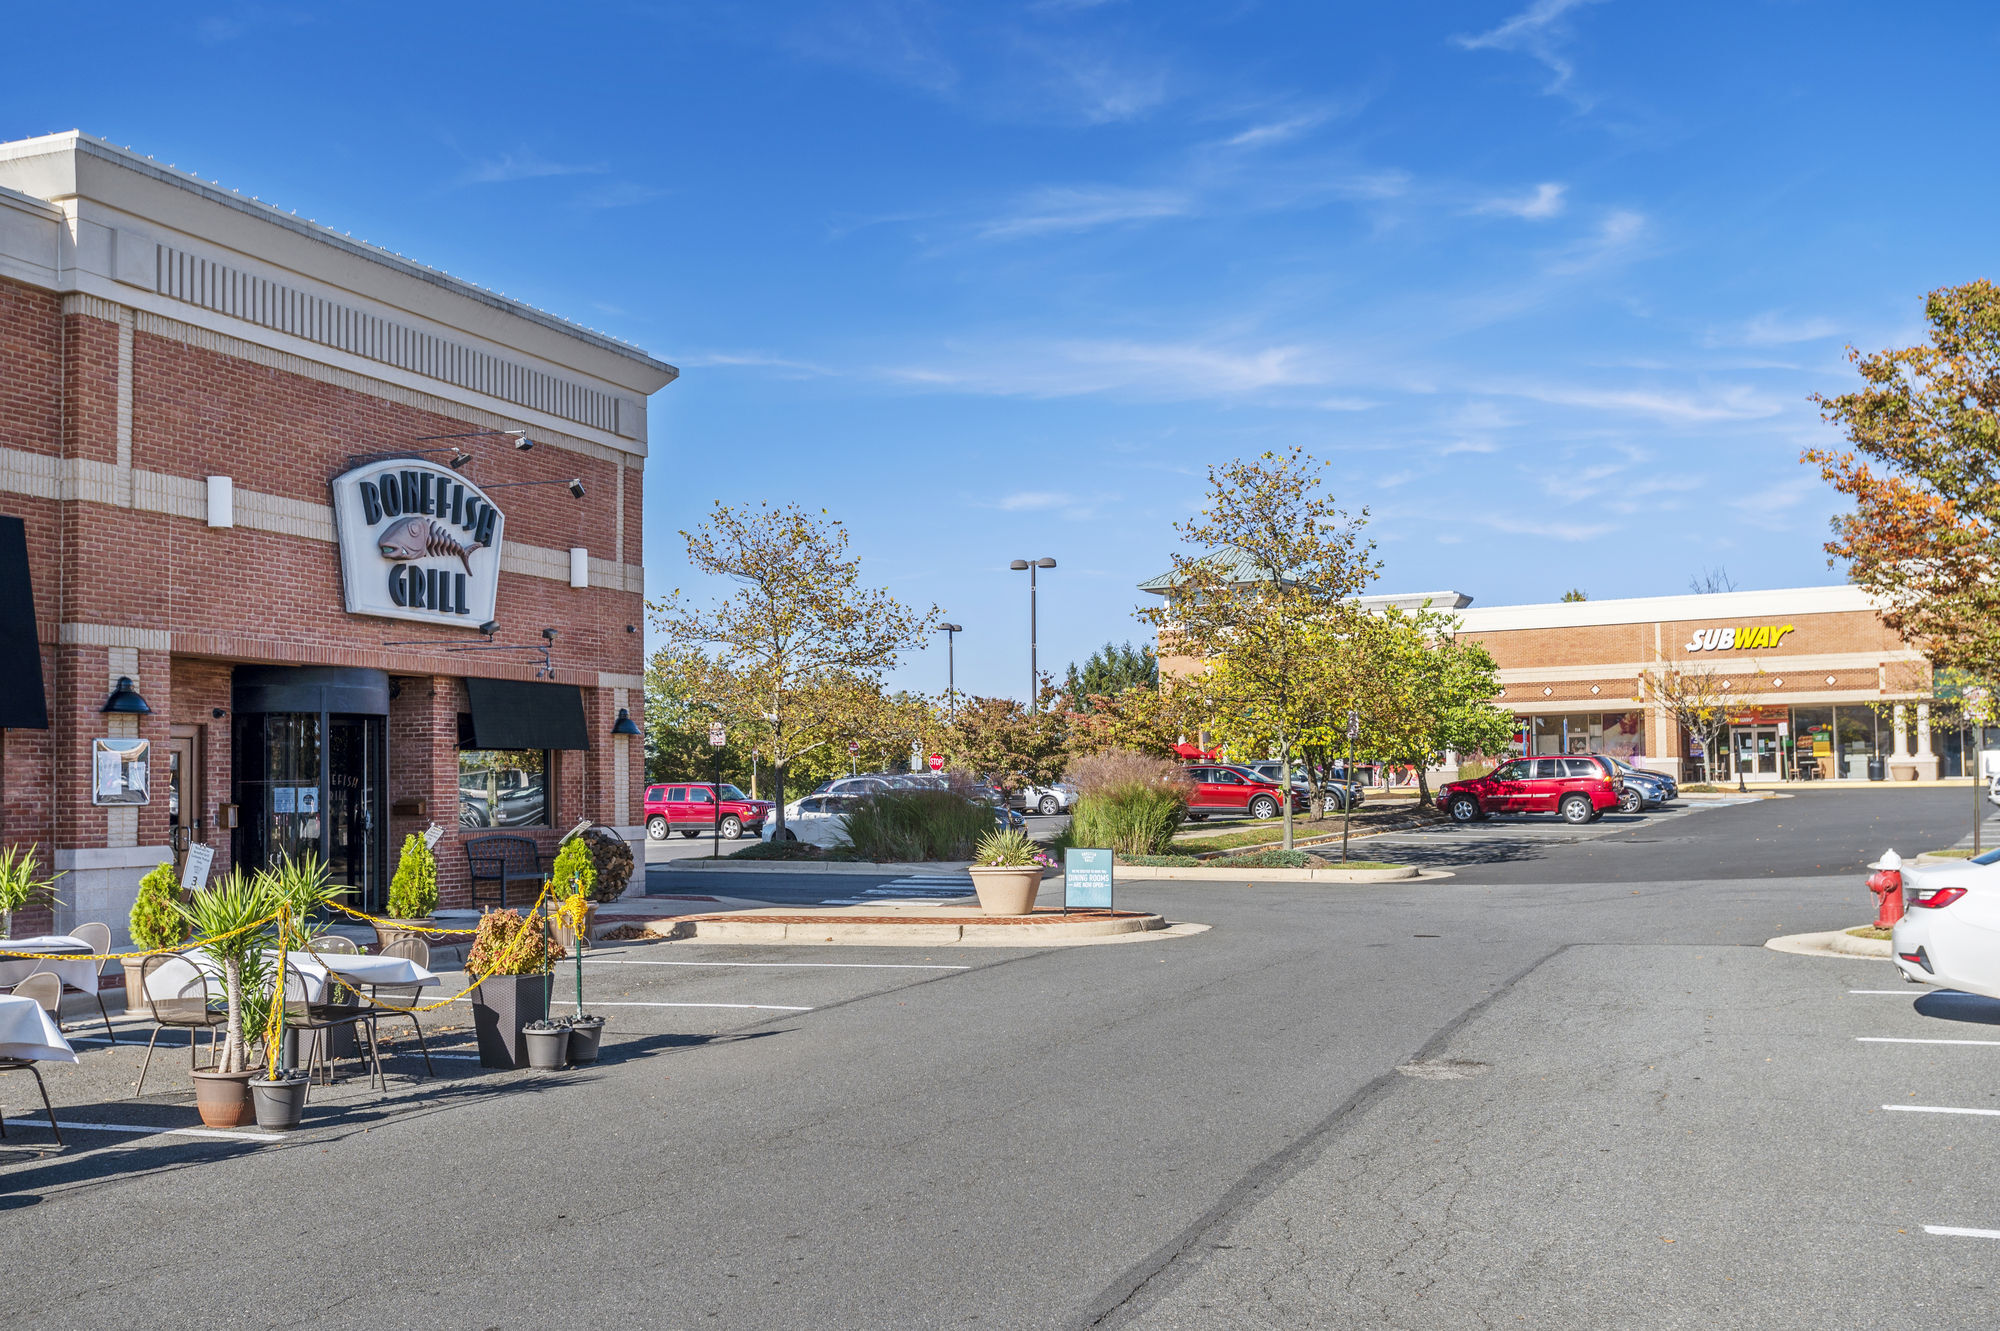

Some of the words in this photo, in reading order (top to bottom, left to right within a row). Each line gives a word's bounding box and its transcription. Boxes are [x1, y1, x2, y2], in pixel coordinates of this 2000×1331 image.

[360, 471, 498, 547] BONEFISH
[388, 564, 470, 615] GRILL
[1684, 624, 1794, 653] SUBWAY
[929, 757, 944, 767] STOP
[1068, 874, 1088, 882] DINING
[1089, 874, 1110, 882] ROOMS
